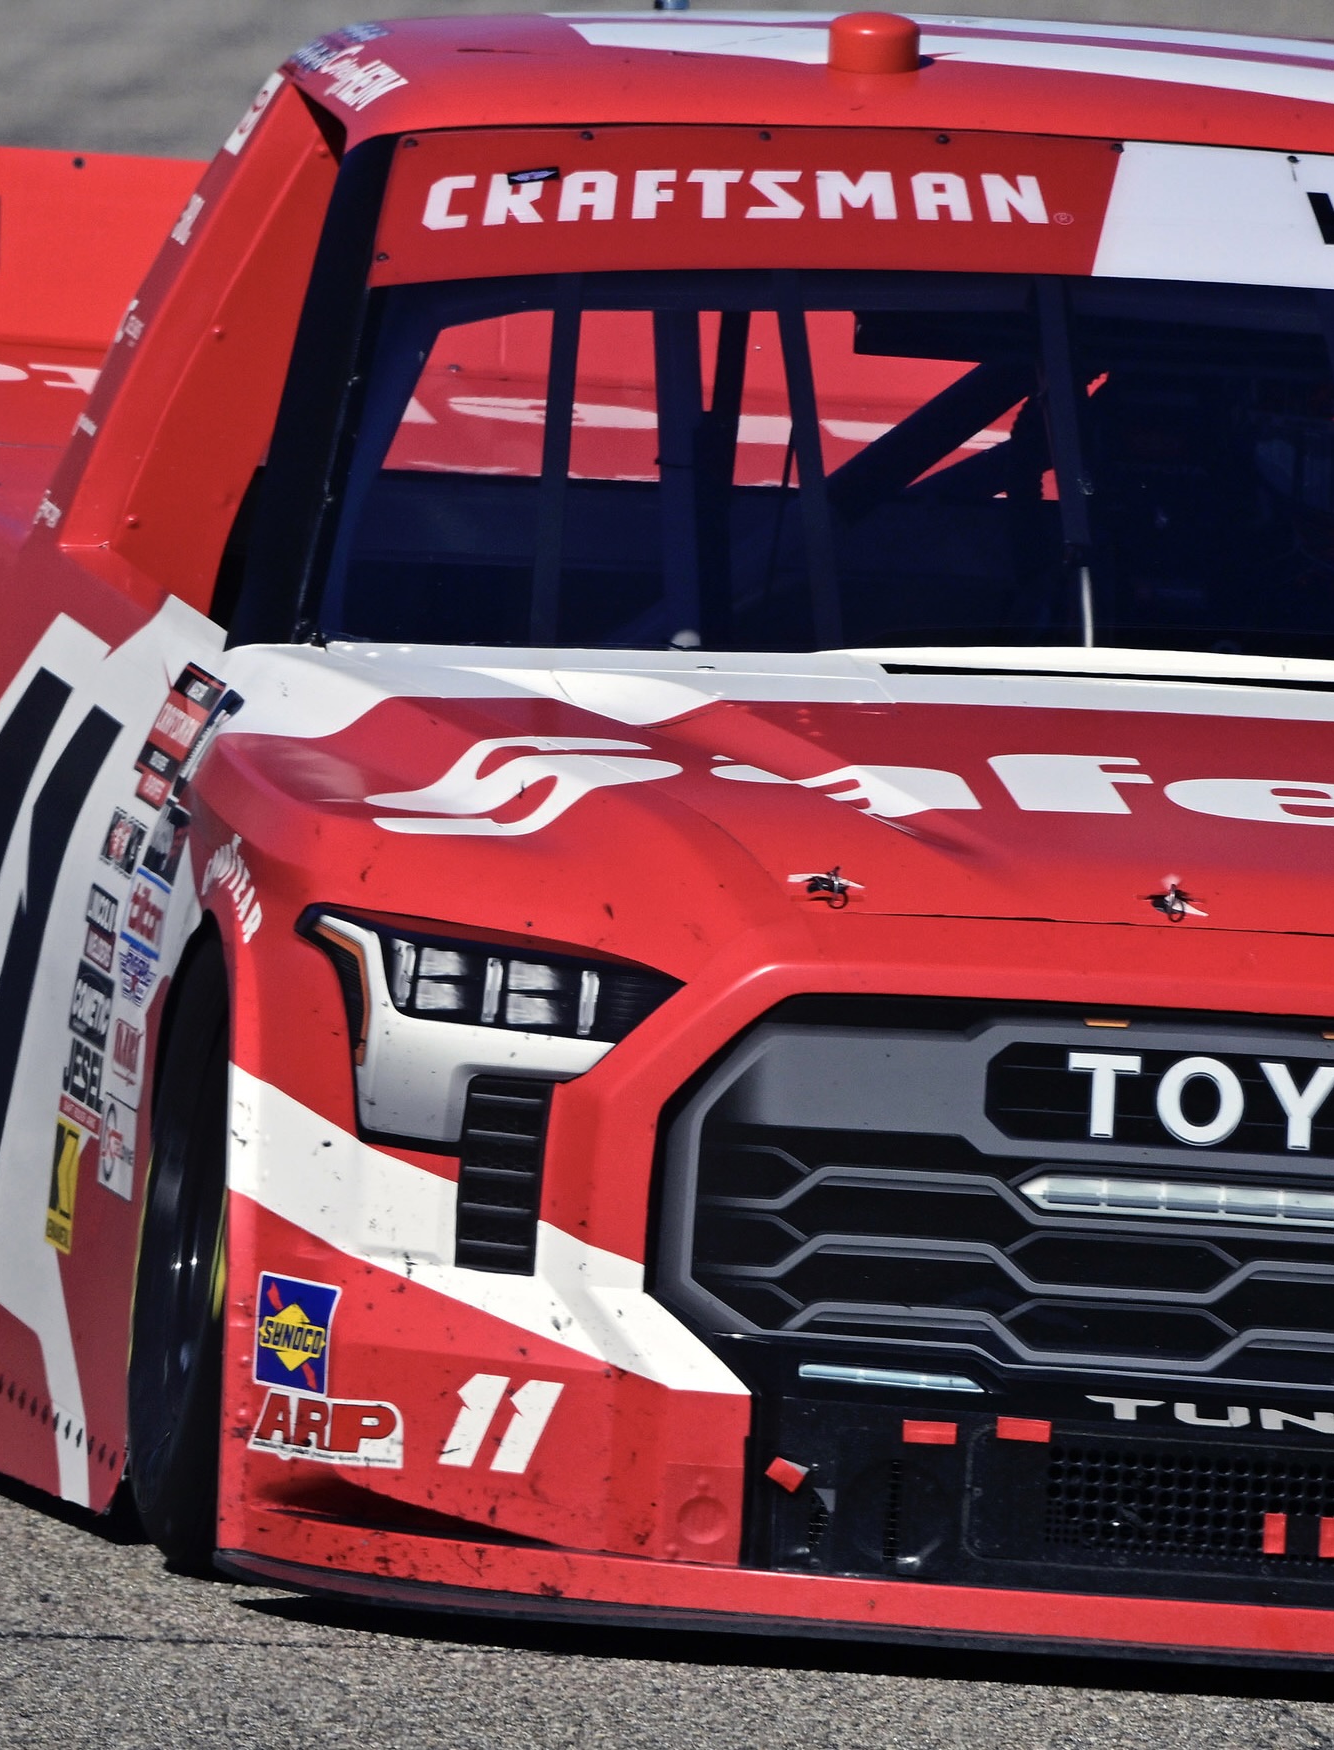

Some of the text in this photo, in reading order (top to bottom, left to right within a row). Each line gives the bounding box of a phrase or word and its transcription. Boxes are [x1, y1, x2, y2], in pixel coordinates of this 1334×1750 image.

[422, 169, 1050, 231] CRAFTSMAN
[63, 1036, 104, 1115] JESEL
[262, 1319, 324, 1355] SUNOCO
[254, 1392, 398, 1453] ARP
[437, 1372, 565, 1474] 11
